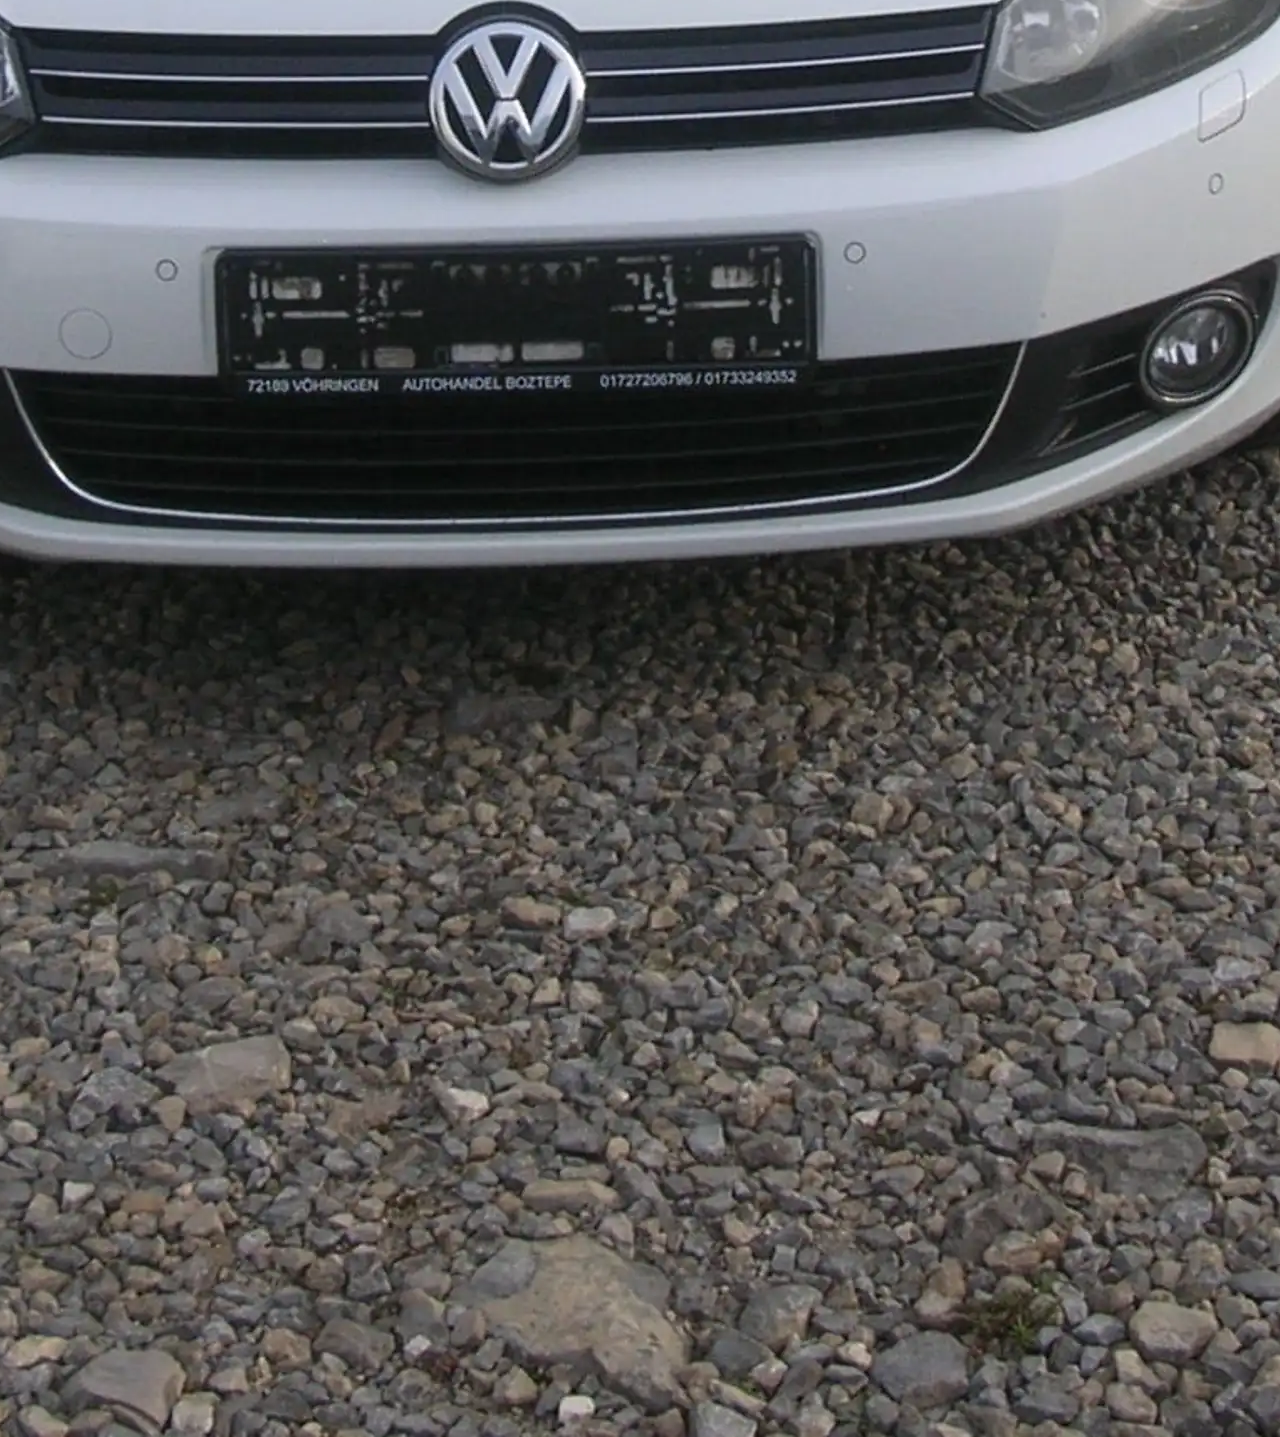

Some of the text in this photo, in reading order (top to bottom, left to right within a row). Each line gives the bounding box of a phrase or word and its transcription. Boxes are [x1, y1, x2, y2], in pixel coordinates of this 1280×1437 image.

[430, 22, 585, 180] VW
[292, 376, 380, 393] VÖHRINGEN
[402, 374, 572, 392] AUTOHANDEL BOZTEPE
